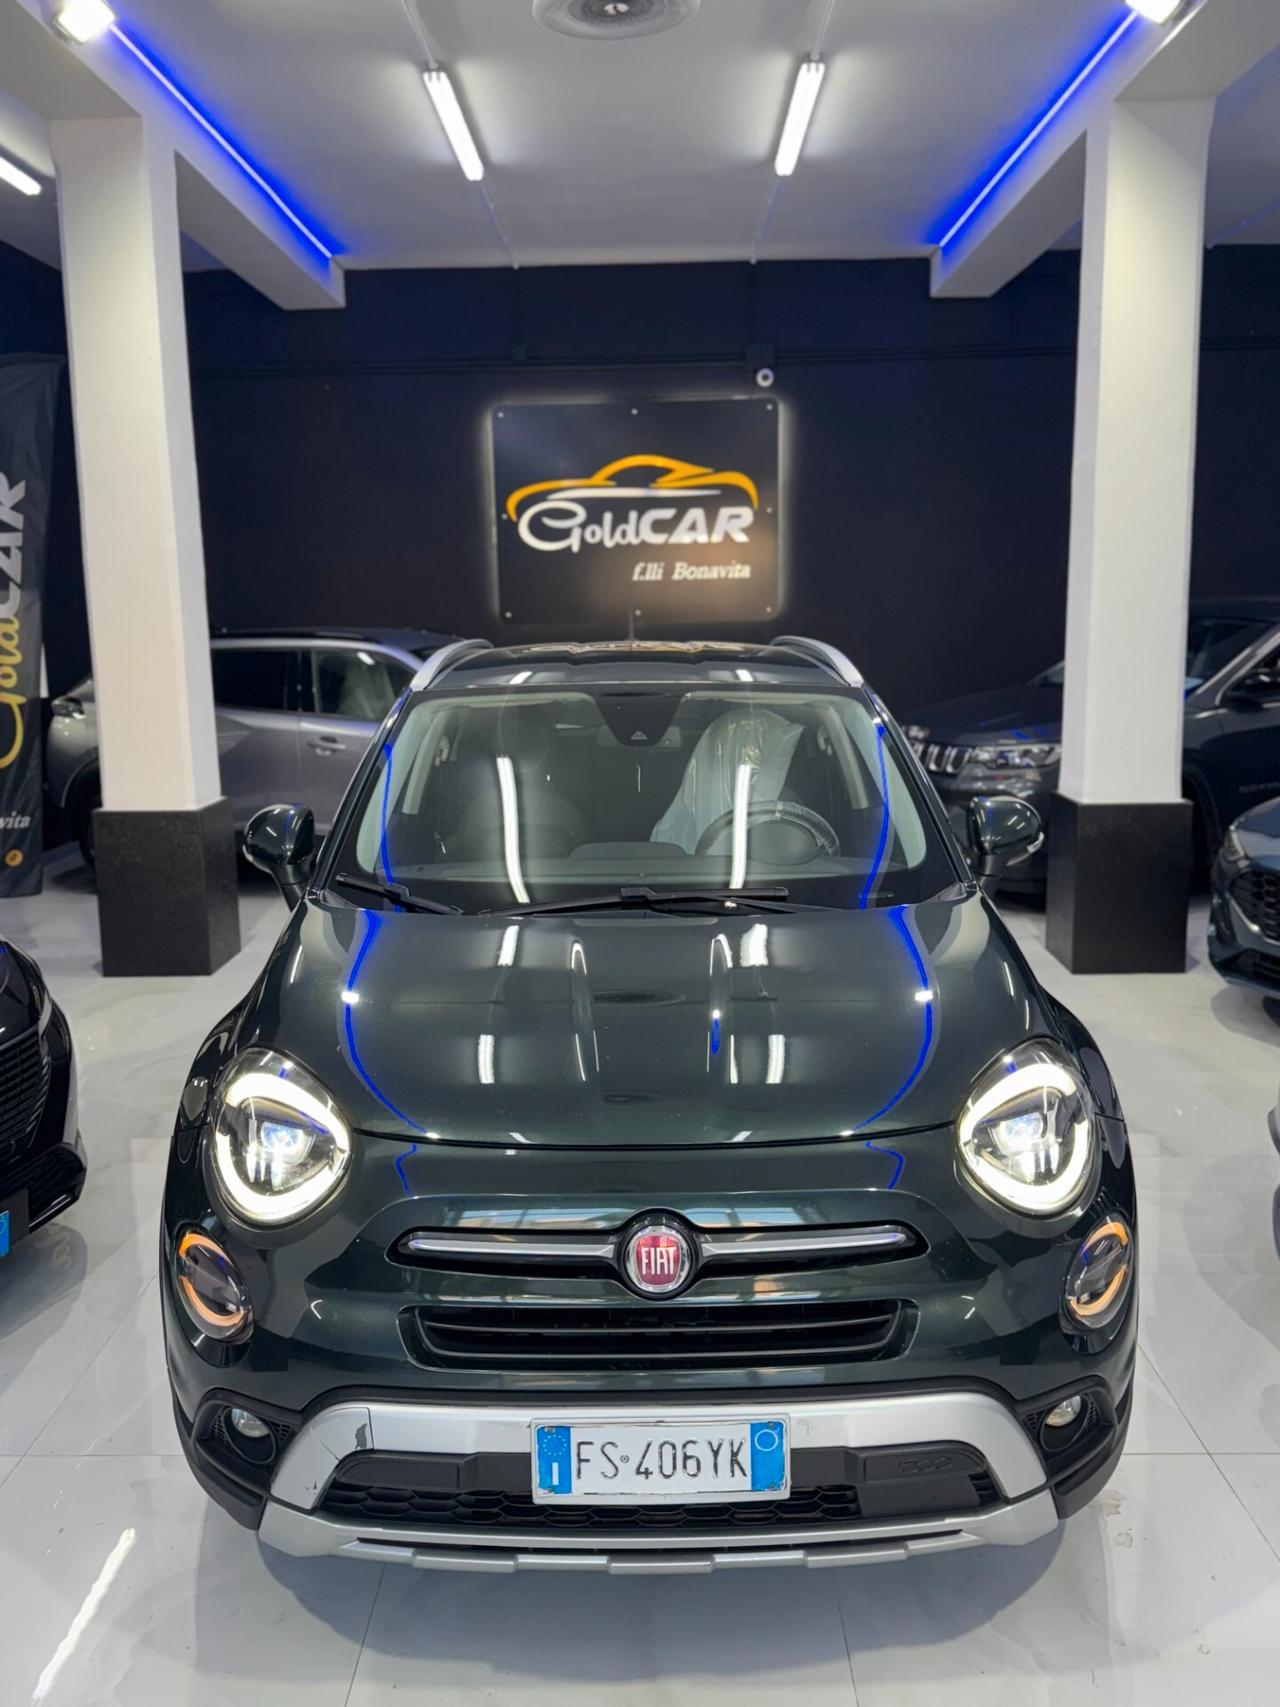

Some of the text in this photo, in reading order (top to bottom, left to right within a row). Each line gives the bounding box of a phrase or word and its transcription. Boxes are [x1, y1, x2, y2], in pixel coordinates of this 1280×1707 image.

[518, 499, 754, 553] GoldCAR
[672, 560, 751, 580] Bonavita
[641, 1246, 677, 1275] FIAT
